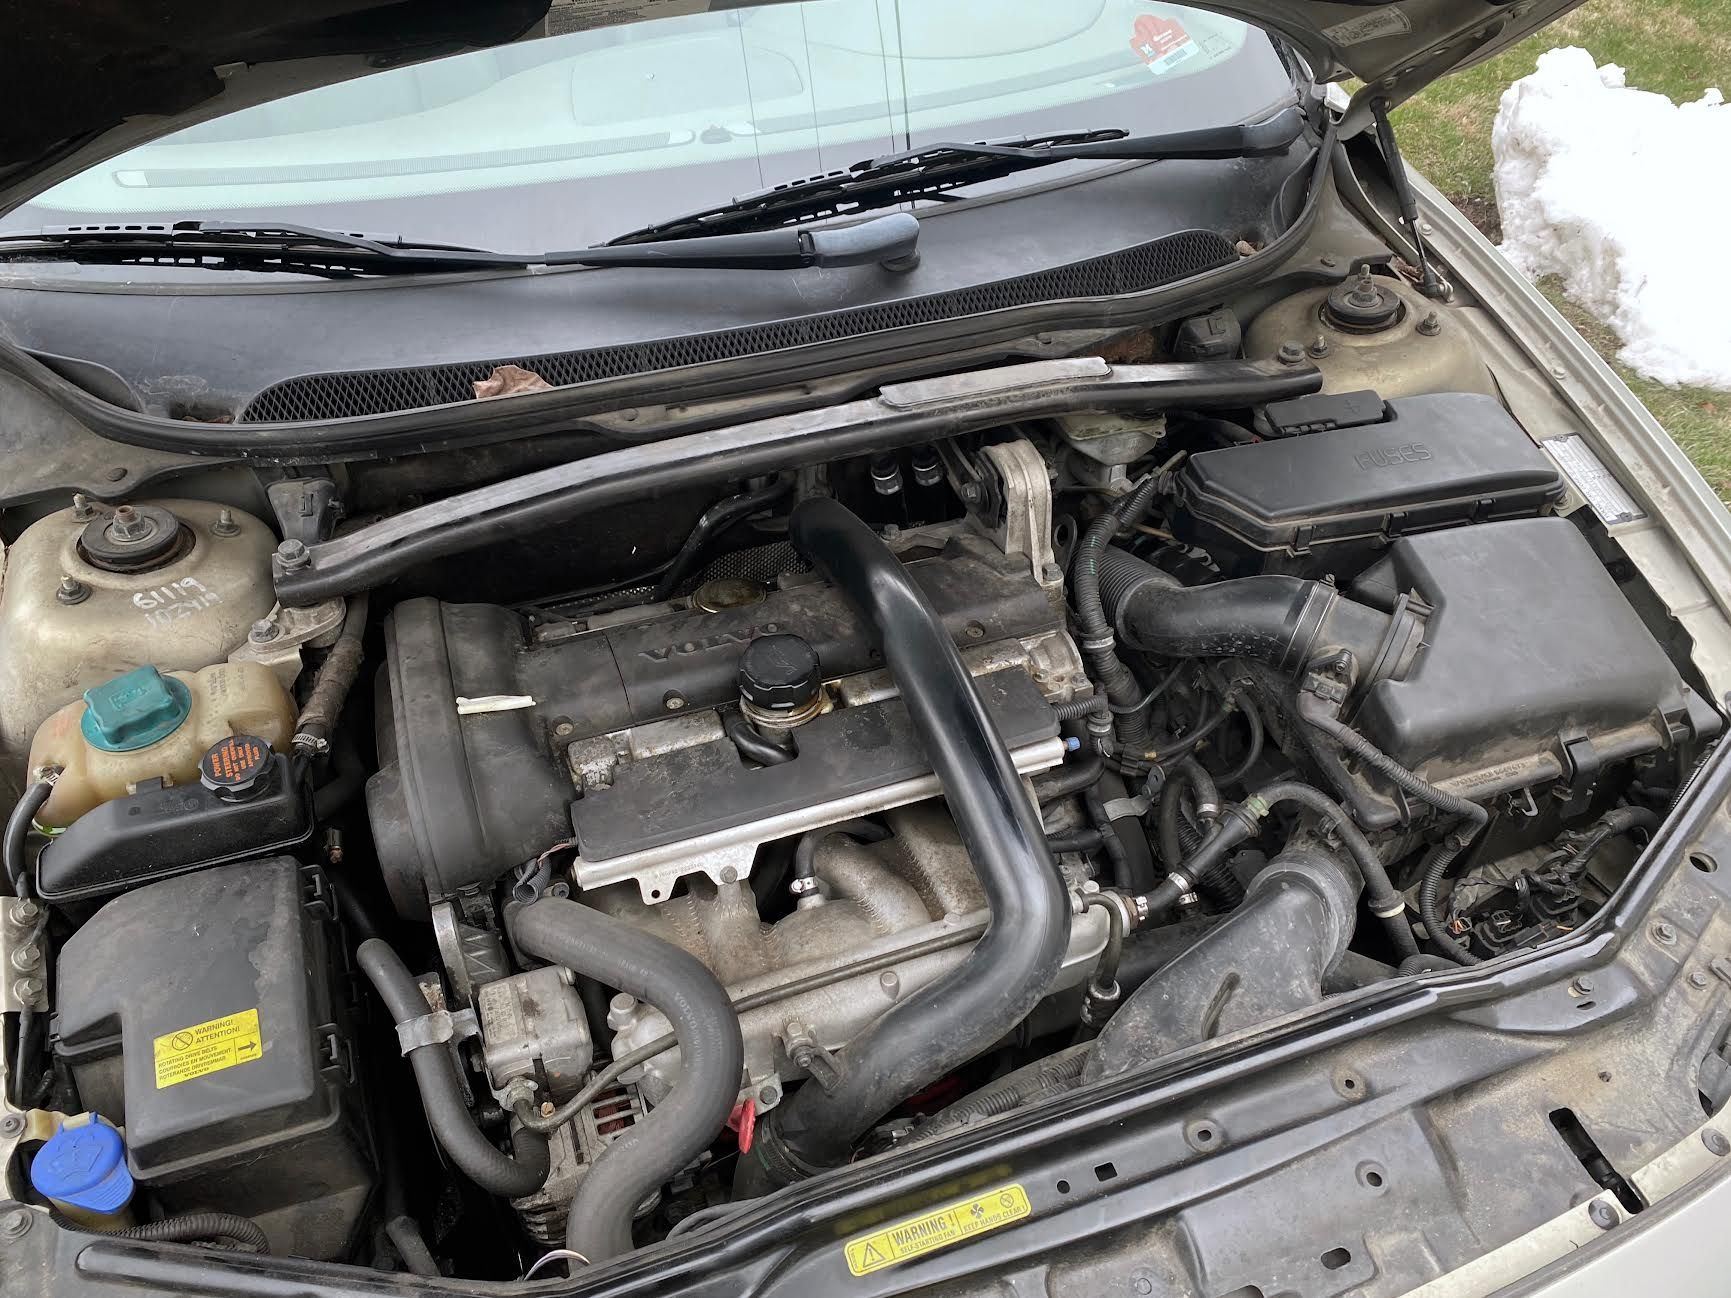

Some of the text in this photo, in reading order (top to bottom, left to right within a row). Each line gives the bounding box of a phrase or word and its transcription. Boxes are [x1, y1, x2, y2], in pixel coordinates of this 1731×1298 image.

[1353, 441, 1432, 472] FUSES
[212, 753, 221, 777] POWER
[221, 746, 233, 778] STEERING
[194, 1019, 234, 1035] WARNING!
[195, 1025, 241, 1044] ATTENTION!
[158, 1045, 218, 1068] ROTATING DRIVE BELTS
[184, 1067, 210, 1078] VOLVO
[892, 1216, 947, 1246] WARNING
[963, 1221, 979, 1233] KEEP
[980, 1213, 1001, 1229] HANDS
[1002, 1207, 1022, 1219] CLEAR
[900, 1229, 956, 1254] SELF-STARTING FAN
